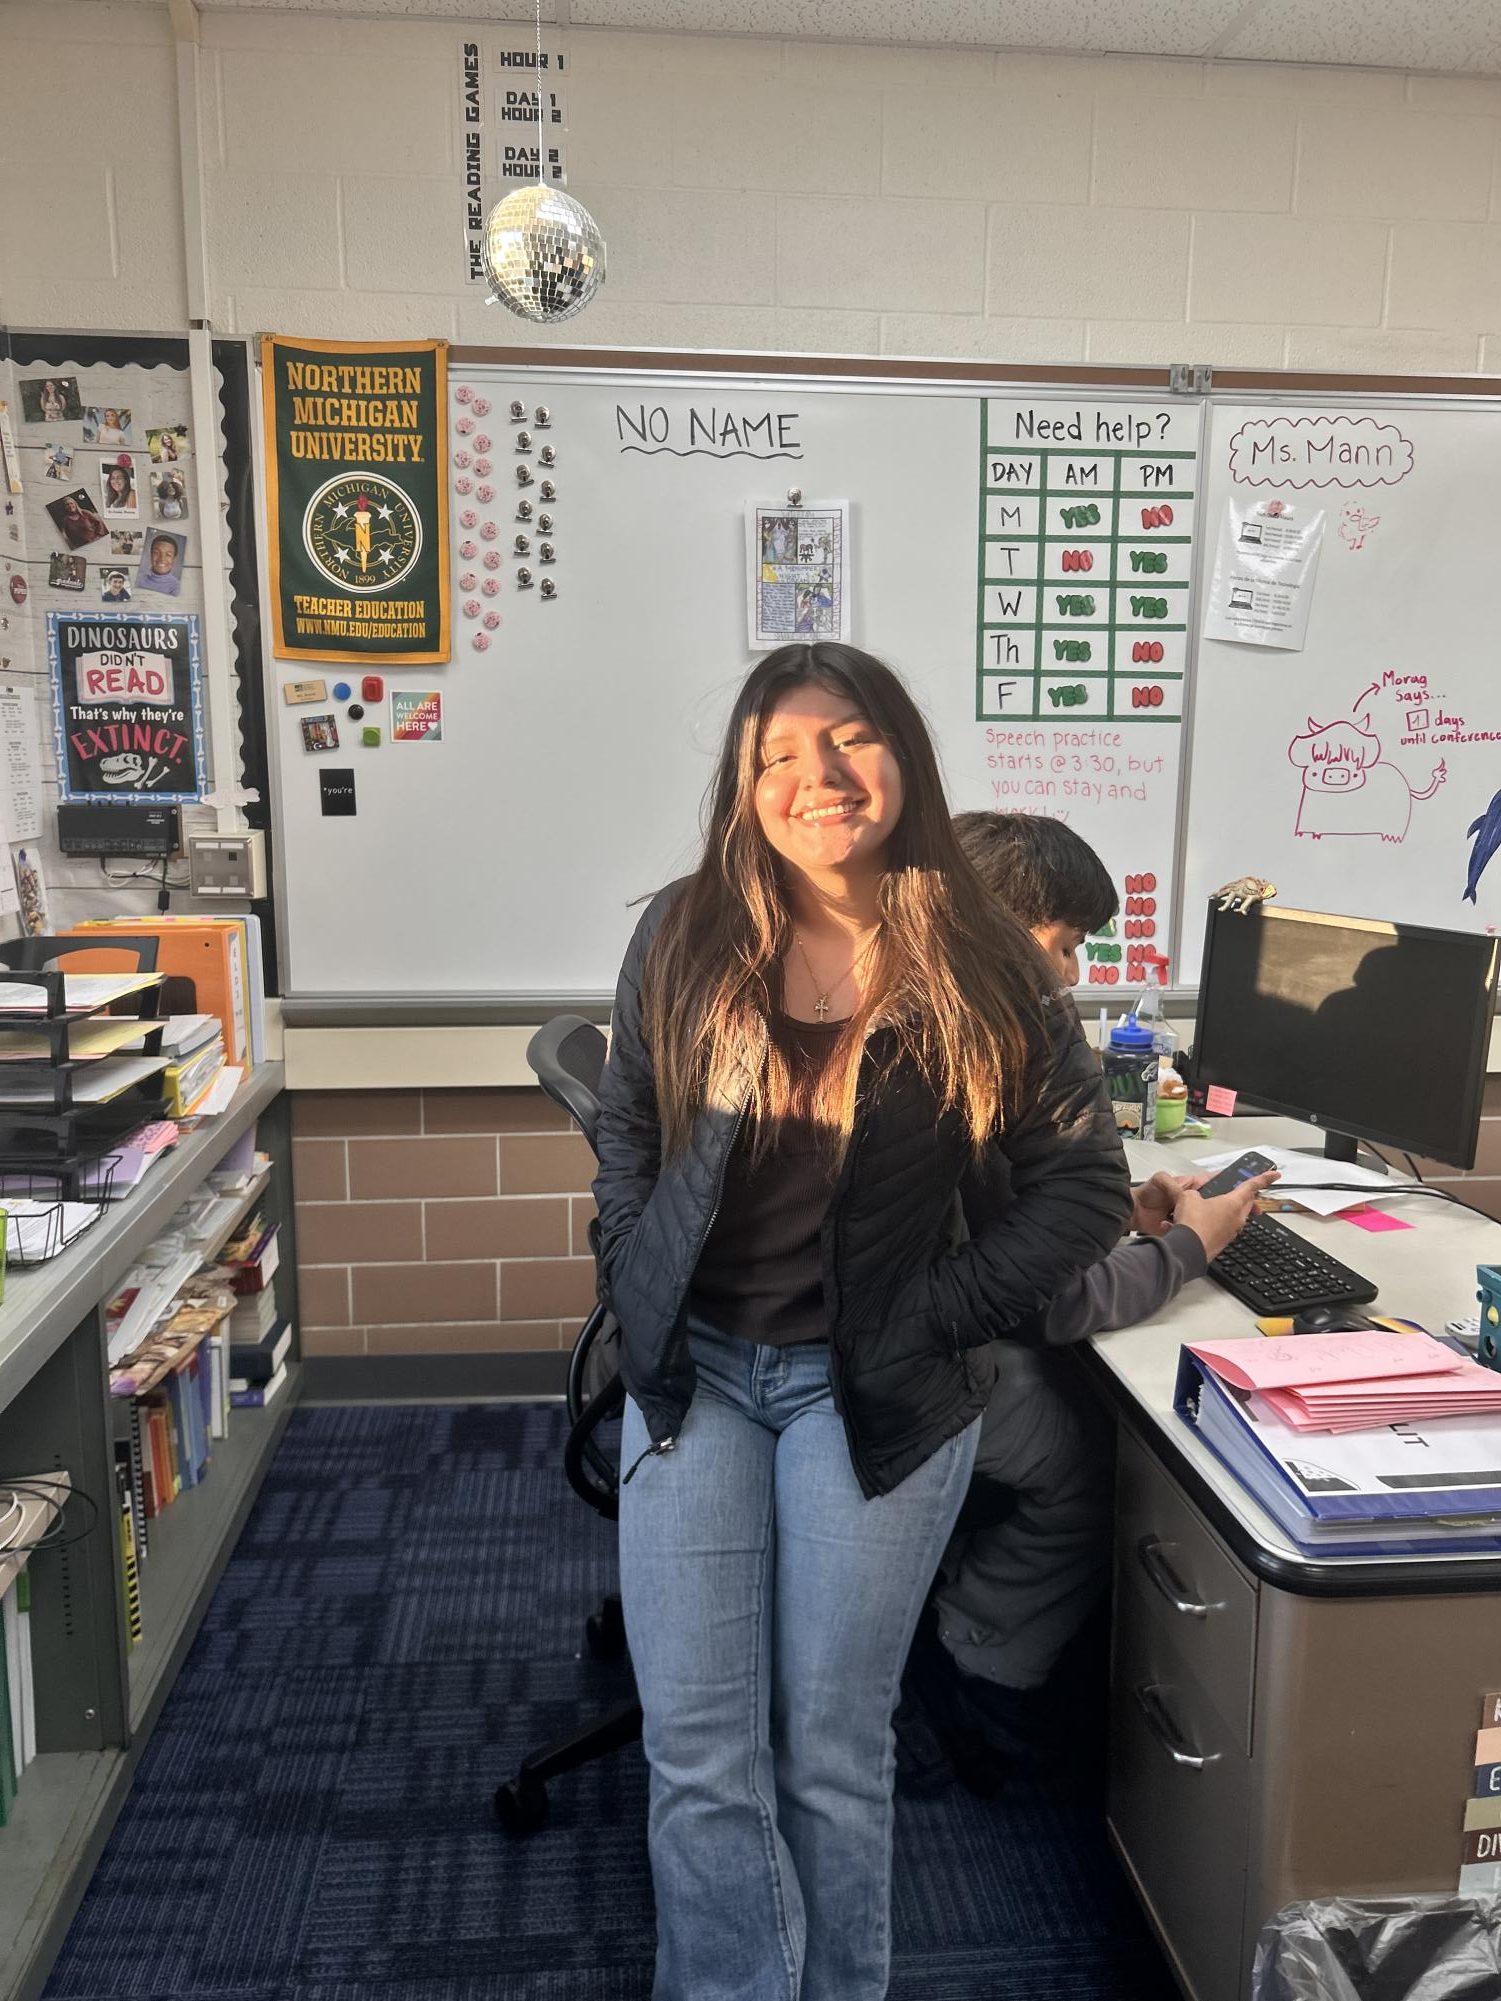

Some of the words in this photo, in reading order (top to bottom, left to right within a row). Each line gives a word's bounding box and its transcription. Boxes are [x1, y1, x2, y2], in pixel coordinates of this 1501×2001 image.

[500, 52, 548, 69] HOUR
[557, 55, 564, 70] 1
[463, 43, 480, 122] GAMES
[505, 92, 539, 106] DAY
[550, 94, 557, 107] 1
[501, 107, 543, 122] HOUR
[551, 109, 561, 123] 2
[504, 147, 540, 162] DAY
[549, 149, 558, 162] 2
[466, 132, 483, 231] READING
[502, 163, 544, 178] HOUR
[552, 165, 562, 179] 2
[469, 240, 484, 280] THE
[286, 361, 422, 394] NORTHERN
[292, 397, 418, 429] MICHIGAN
[617, 405, 669, 442] NO
[689, 407, 801, 448] NAME
[1015, 409, 1081, 441] Need
[1095, 411, 1171, 448] help?
[1252, 435, 1296, 465] Ms.
[1307, 435, 1392, 466] Mann
[991, 462, 1033, 485] DAY
[1065, 463, 1098, 486] AM
[1139, 464, 1174, 487] PM
[322, 482, 390, 508] MICHIGAN
[1000, 506, 1021, 528] M
[1060, 503, 1101, 529] YES
[1141, 504, 1173, 530] NO
[313, 513, 350, 580] NORTHERN
[382, 502, 414, 580] UNIVERSITY
[1000, 547, 1020, 577] T
[1062, 550, 1094, 572] NO
[1129, 550, 1168, 574] YES
[355, 574, 376, 584] 1899
[294, 595, 352, 618] TEACHER
[355, 599, 425, 620] EDUCATION
[998, 591, 1021, 617] W
[1056, 594, 1096, 617] YES
[1129, 595, 1168, 619] YES
[67, 626, 178, 650] DINOSAURS
[296, 618, 426, 639] WWW.NMU.EDU/EDUCATION
[100, 652, 145, 667] DIDN'T
[990, 634, 1020, 664] Th
[1053, 639, 1092, 663] YES
[1132, 641, 1164, 664] NO
[86, 668, 165, 695] READ
[1382, 670, 1427, 688] Morag
[396, 701, 417, 711] ALL
[417, 701, 438, 711] ARE
[997, 682, 1017, 710] F
[1047, 684, 1088, 708] YES
[1132, 685, 1164, 709] NO
[70, 706, 109, 721] That's
[112, 707, 136, 723] why
[141, 708, 184, 724] they're
[396, 712, 439, 721] WELCOME
[396, 722, 427, 731] HERE
[1435, 710, 1465, 732] days
[986, 729, 1046, 749] Speech
[1053, 729, 1121, 752] practice
[1400, 733, 1426, 746] until
[987, 753, 1044, 769] starts
[1050, 755, 1066, 773] @
[1128, 755, 1164, 773] but
[991, 780, 1020, 798] you
[1024, 780, 1057, 796] can
[1063, 779, 1102, 804] stay
[1108, 782, 1147, 801] and
[1125, 873, 1156, 894] NO
[1125, 896, 1156, 917] NO
[1125, 919, 1155, 939] NO
[1085, 942, 1122, 963] YES
[1089, 964, 1119, 985] NO
[1126, 962, 1145, 982] N
